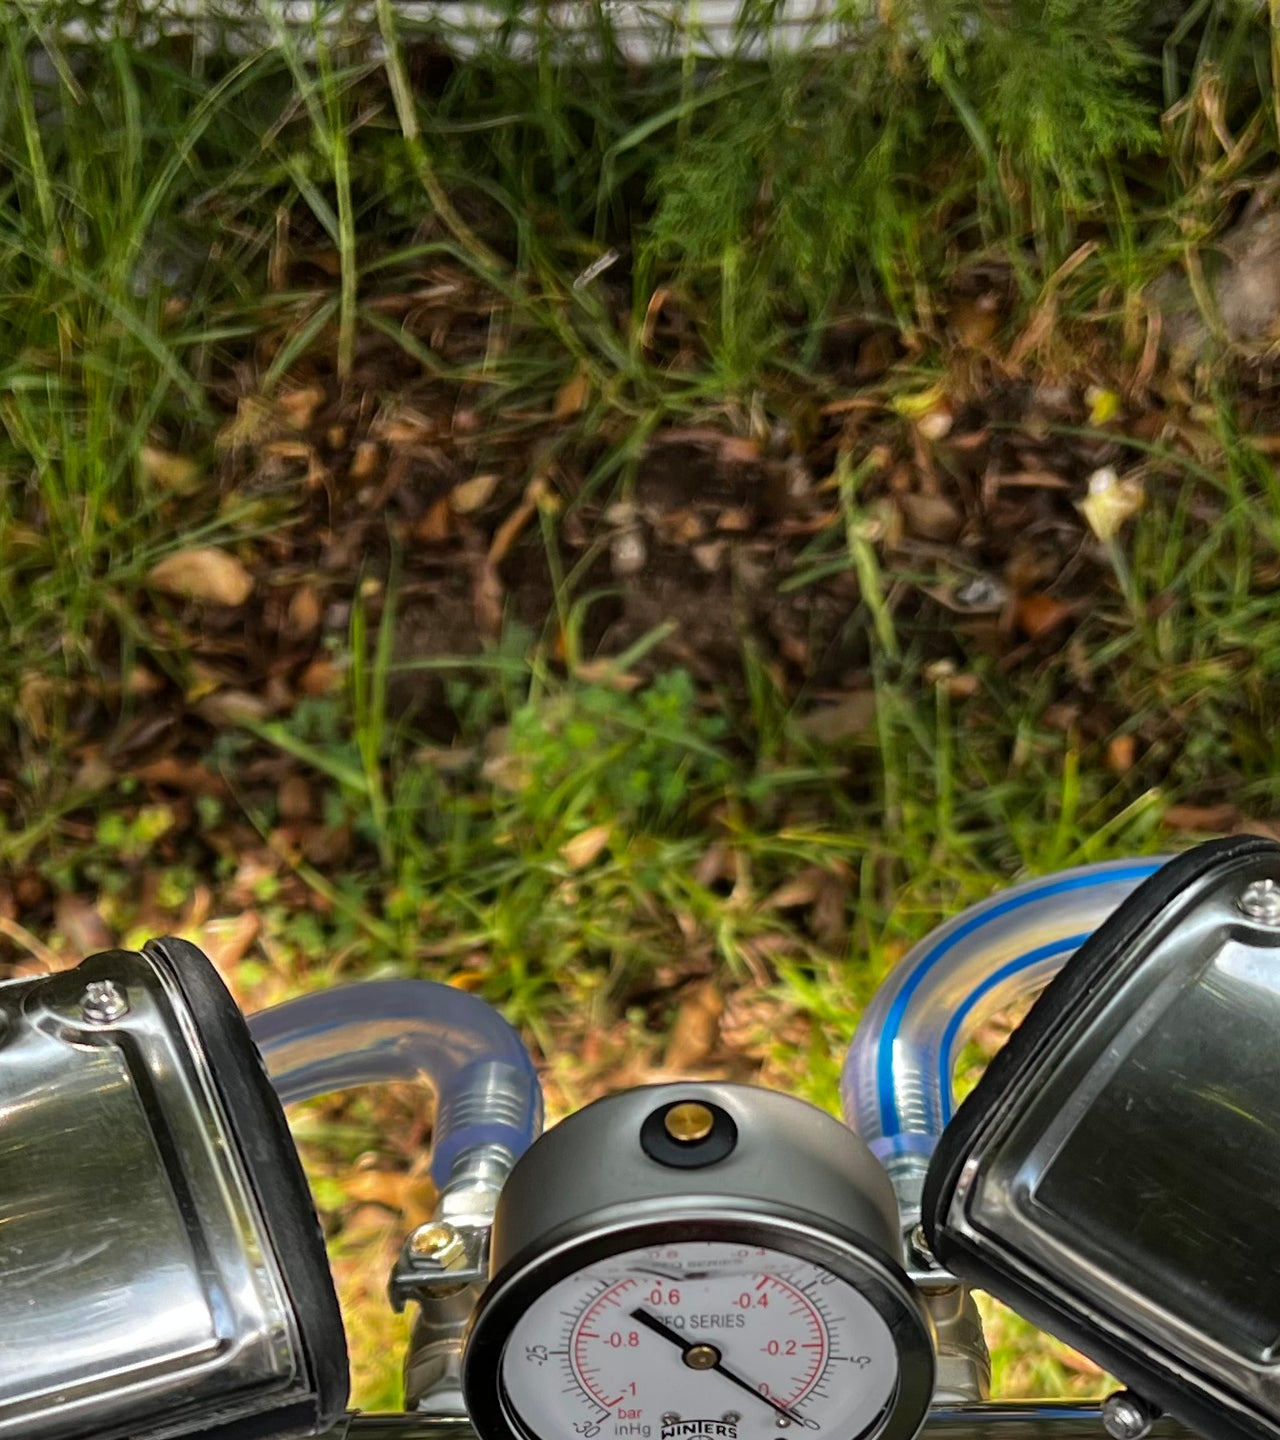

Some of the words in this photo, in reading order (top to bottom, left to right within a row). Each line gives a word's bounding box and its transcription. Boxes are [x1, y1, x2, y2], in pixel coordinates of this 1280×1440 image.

[643, 1289, 681, 1306] -0.6
[732, 1292, 769, 1310] -0.4
[689, 1314, 746, 1329] SERIES
[603, 1331, 640, 1348] -0.8
[760, 1339, 797, 1356] -0.2
[525, 1344, 549, 1367] -25
[620, 1381, 637, 1396] -1
[616, 1407, 643, 1420] bar
[572, 1420, 602, 1439] -30
[614, 1423, 652, 1438] inHg
[660, 1420, 738, 1440] WINTERS
[802, 1418, 821, 1431] 0
